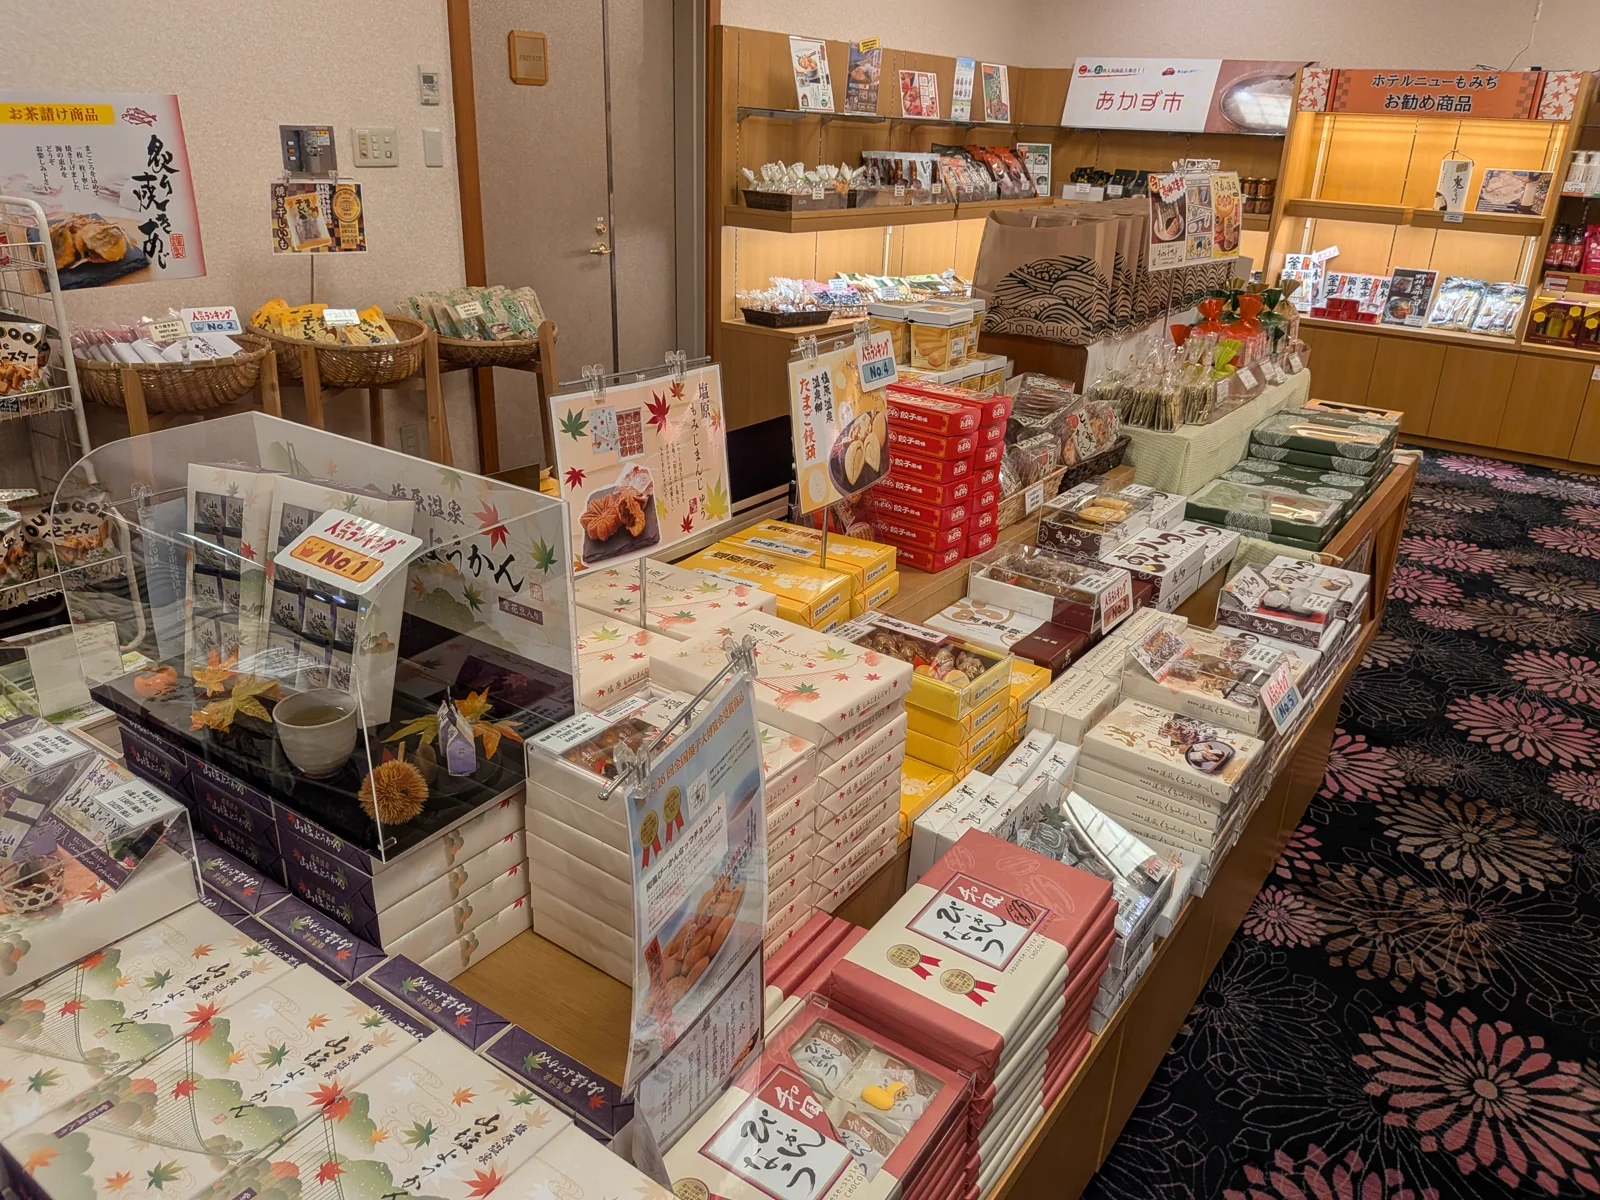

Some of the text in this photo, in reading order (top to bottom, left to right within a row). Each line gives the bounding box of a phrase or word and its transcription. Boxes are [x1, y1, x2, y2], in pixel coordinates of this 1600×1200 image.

[519, 54, 543, 62] PRIVATE
[1371, 74, 1499, 90] ホテルニューもみぢ
[9, 107, 99, 122] お茶請け商品
[1384, 94, 1472, 112] お勧め商品
[46, 145, 55, 166] どうぞ
[84, 145, 99, 196] まごころを込めて
[275, 186, 288, 249] 焼き干しいも
[192, 309, 232, 321] 人気ランキング
[207, 322, 235, 331] No.2
[861, 339, 889, 362] 人気ランキング
[869, 364, 889, 379] No.4
[698, 383, 711, 419] 塩原
[811, 375, 823, 415] 温泉郷
[821, 371, 834, 424] 塩原温泉
[799, 378, 817, 461] たまご饅頭
[690, 403, 706, 521] もみじまんじゅう
[392, 483, 465, 526] 塩原温泉
[317, 548, 369, 577] No.1
[1112, 601, 1129, 619] No.3
[749, 622, 784, 639] 塩原
[1279, 695, 1296, 719] No.5
[957, 885, 1005, 909] 和風
[774, 1085, 824, 1119] 和風
[827, 1163, 862, 1200] ese-style
